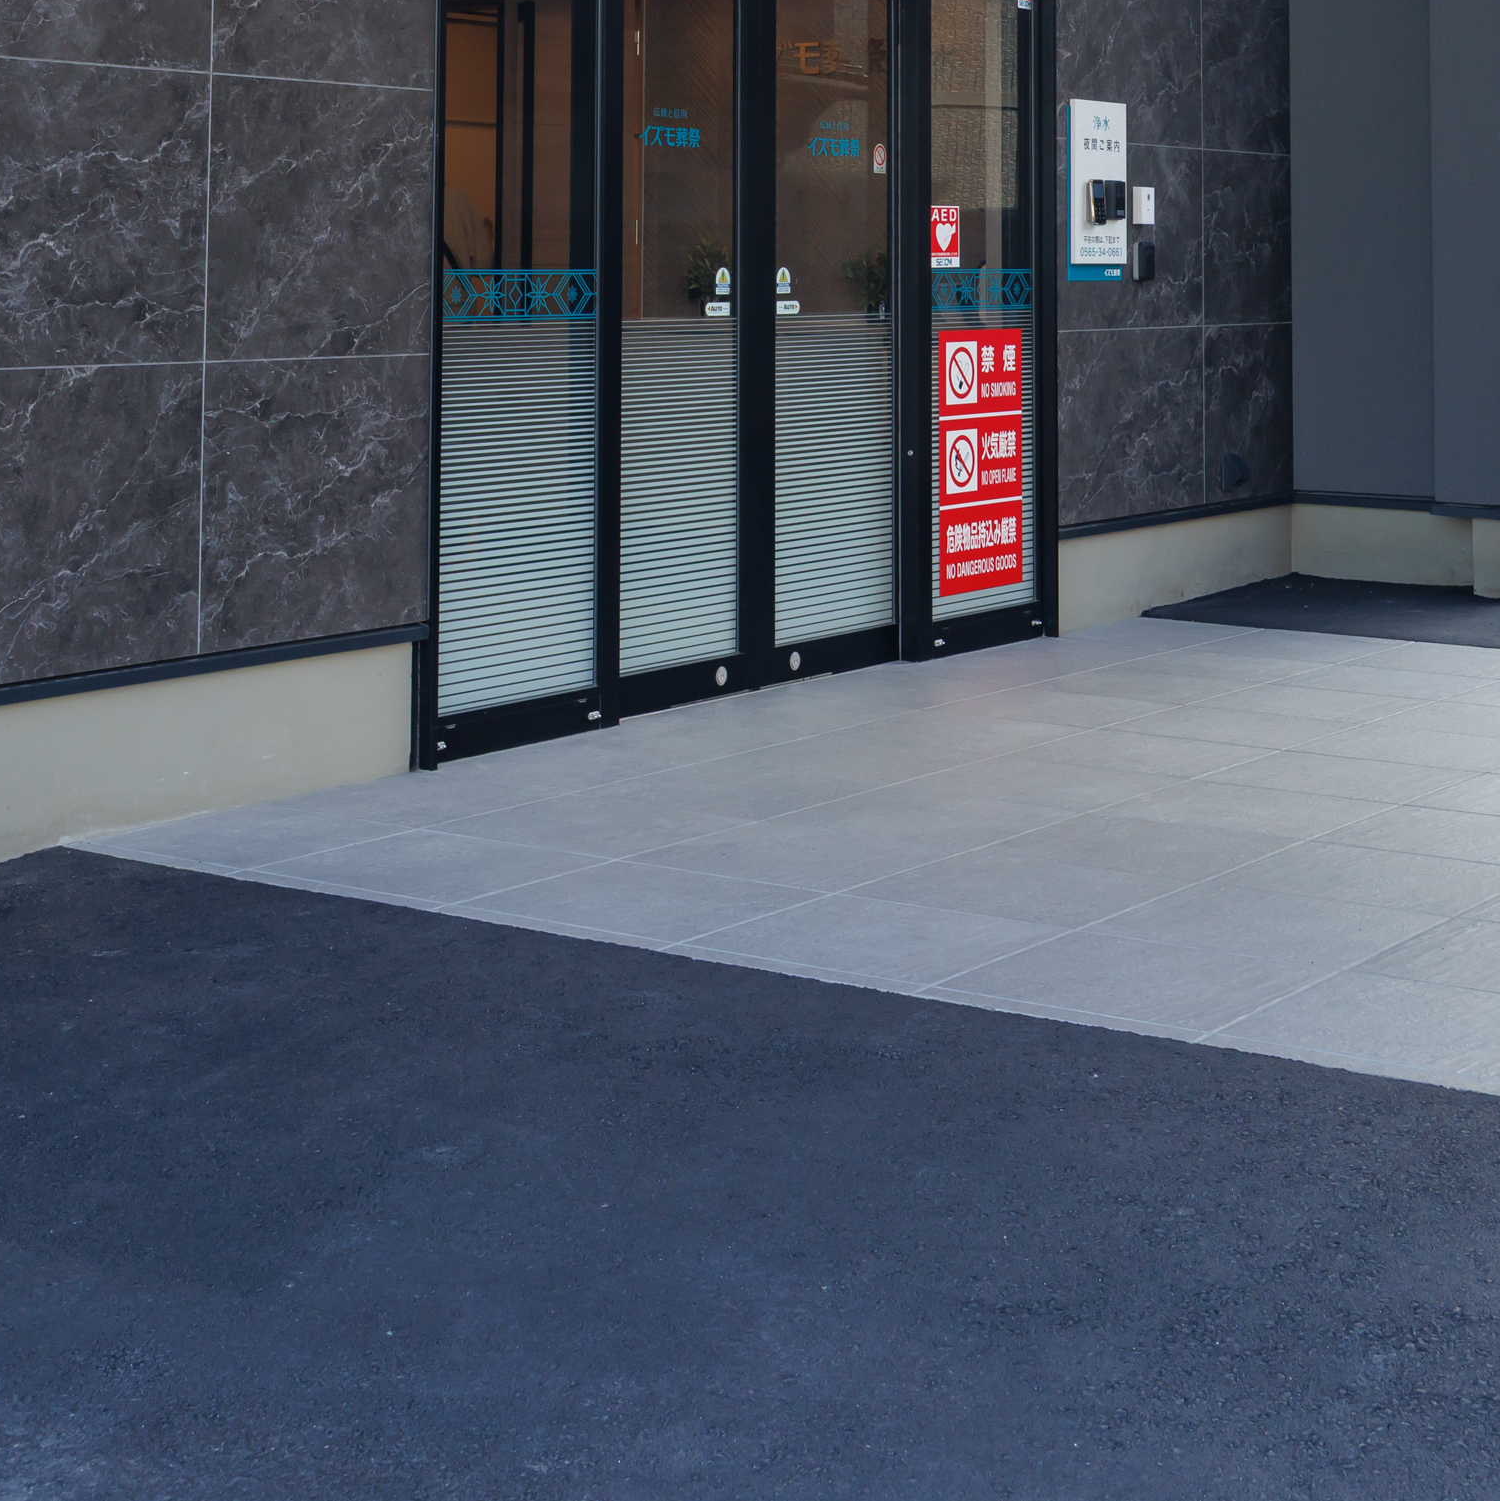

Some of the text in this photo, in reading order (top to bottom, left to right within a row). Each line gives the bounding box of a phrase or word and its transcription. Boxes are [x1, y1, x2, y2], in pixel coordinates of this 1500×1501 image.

[639, 125, 700, 148] イズモ葬祭
[1083, 138, 1120, 153] 夜間ご案内
[808, 137, 860, 158] イズモ葬祭
[931, 209, 957, 222] AED
[1080, 247, 1122, 257] 0565-34-0661
[936, 258, 952, 266] SECOM
[981, 344, 1016, 373] 禁煙
[981, 381, 1016, 398] NO SMOKING
[981, 430, 1016, 460] 火気厳禁
[981, 467, 1016, 485] NO OPEN FLAME
[946, 516, 1016, 553] 危険物品持込み厳禁
[946, 553, 1017, 580] NO DANGEROUS GOODS
